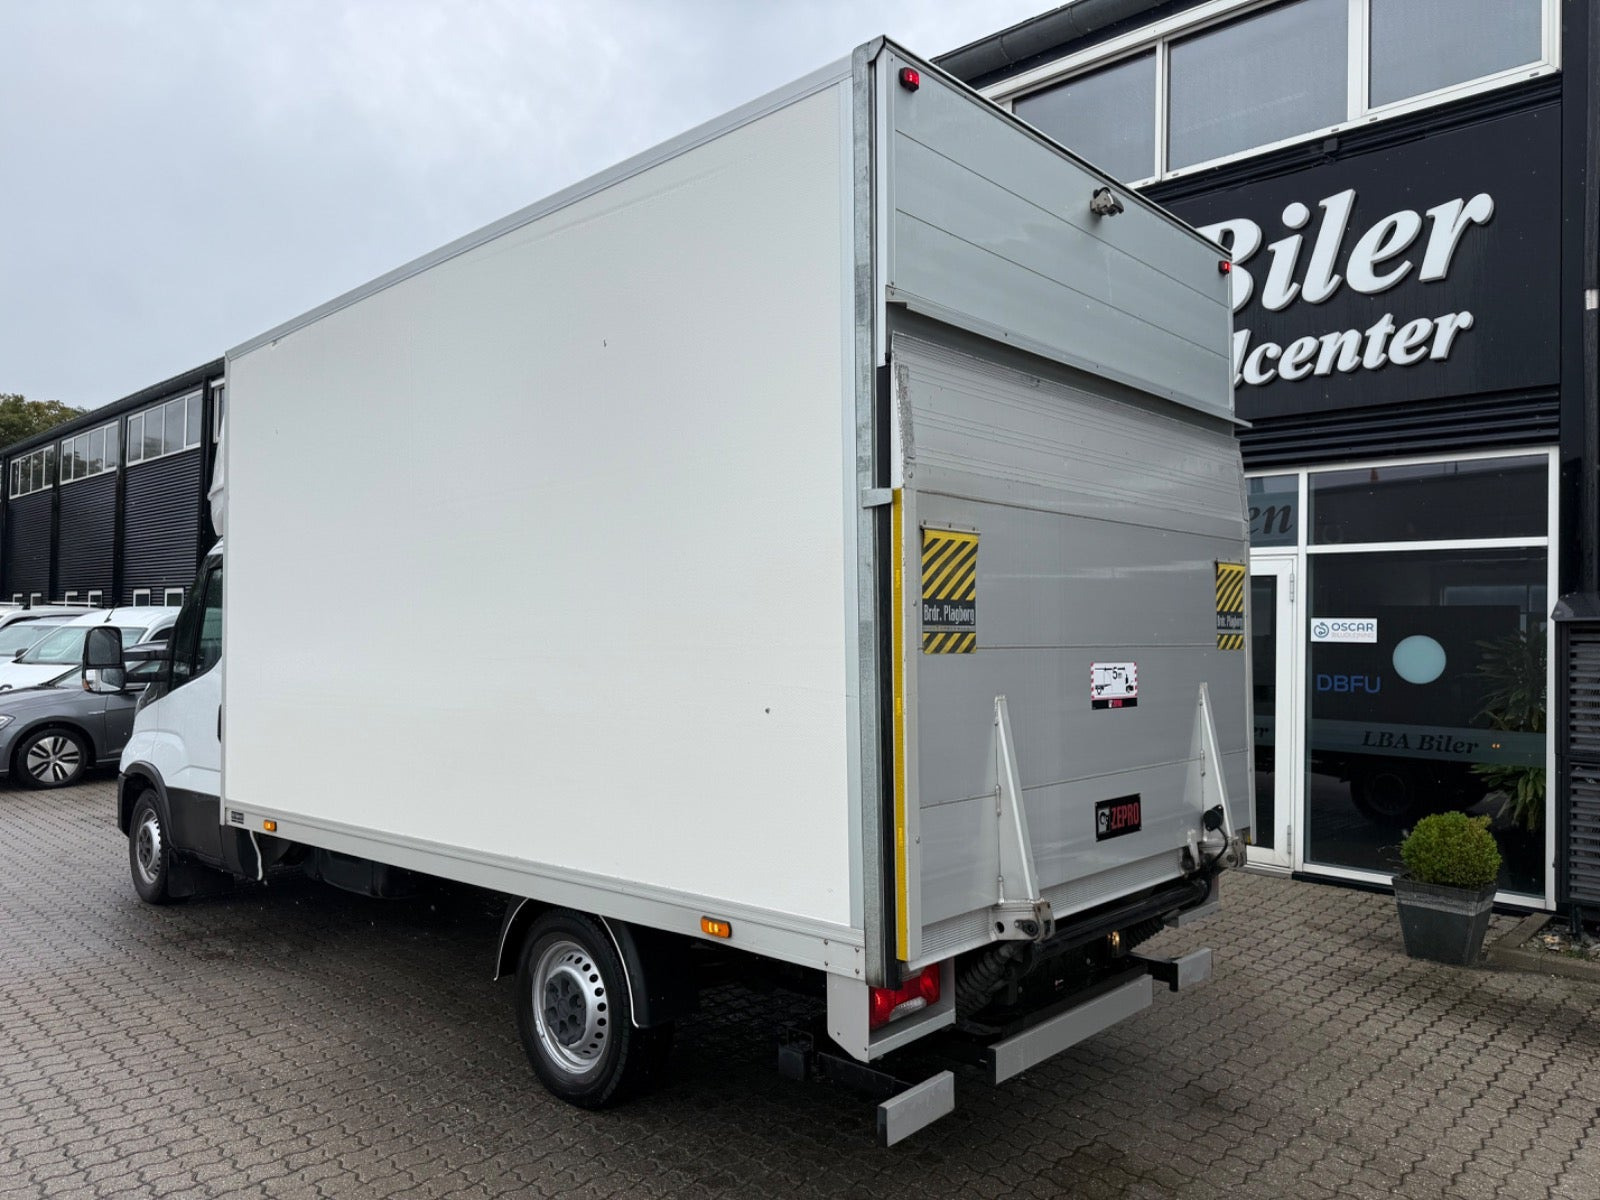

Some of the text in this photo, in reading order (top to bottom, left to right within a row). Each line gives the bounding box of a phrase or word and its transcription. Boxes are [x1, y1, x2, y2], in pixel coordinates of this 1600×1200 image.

[1196, 188, 1494, 313] Biler
[1331, 622, 1375, 632] OSCAR
[1316, 673, 1381, 694] DBFU
[1361, 730, 1480, 755] LBA Biler
[1111, 802, 1139, 830] ZEPRO
